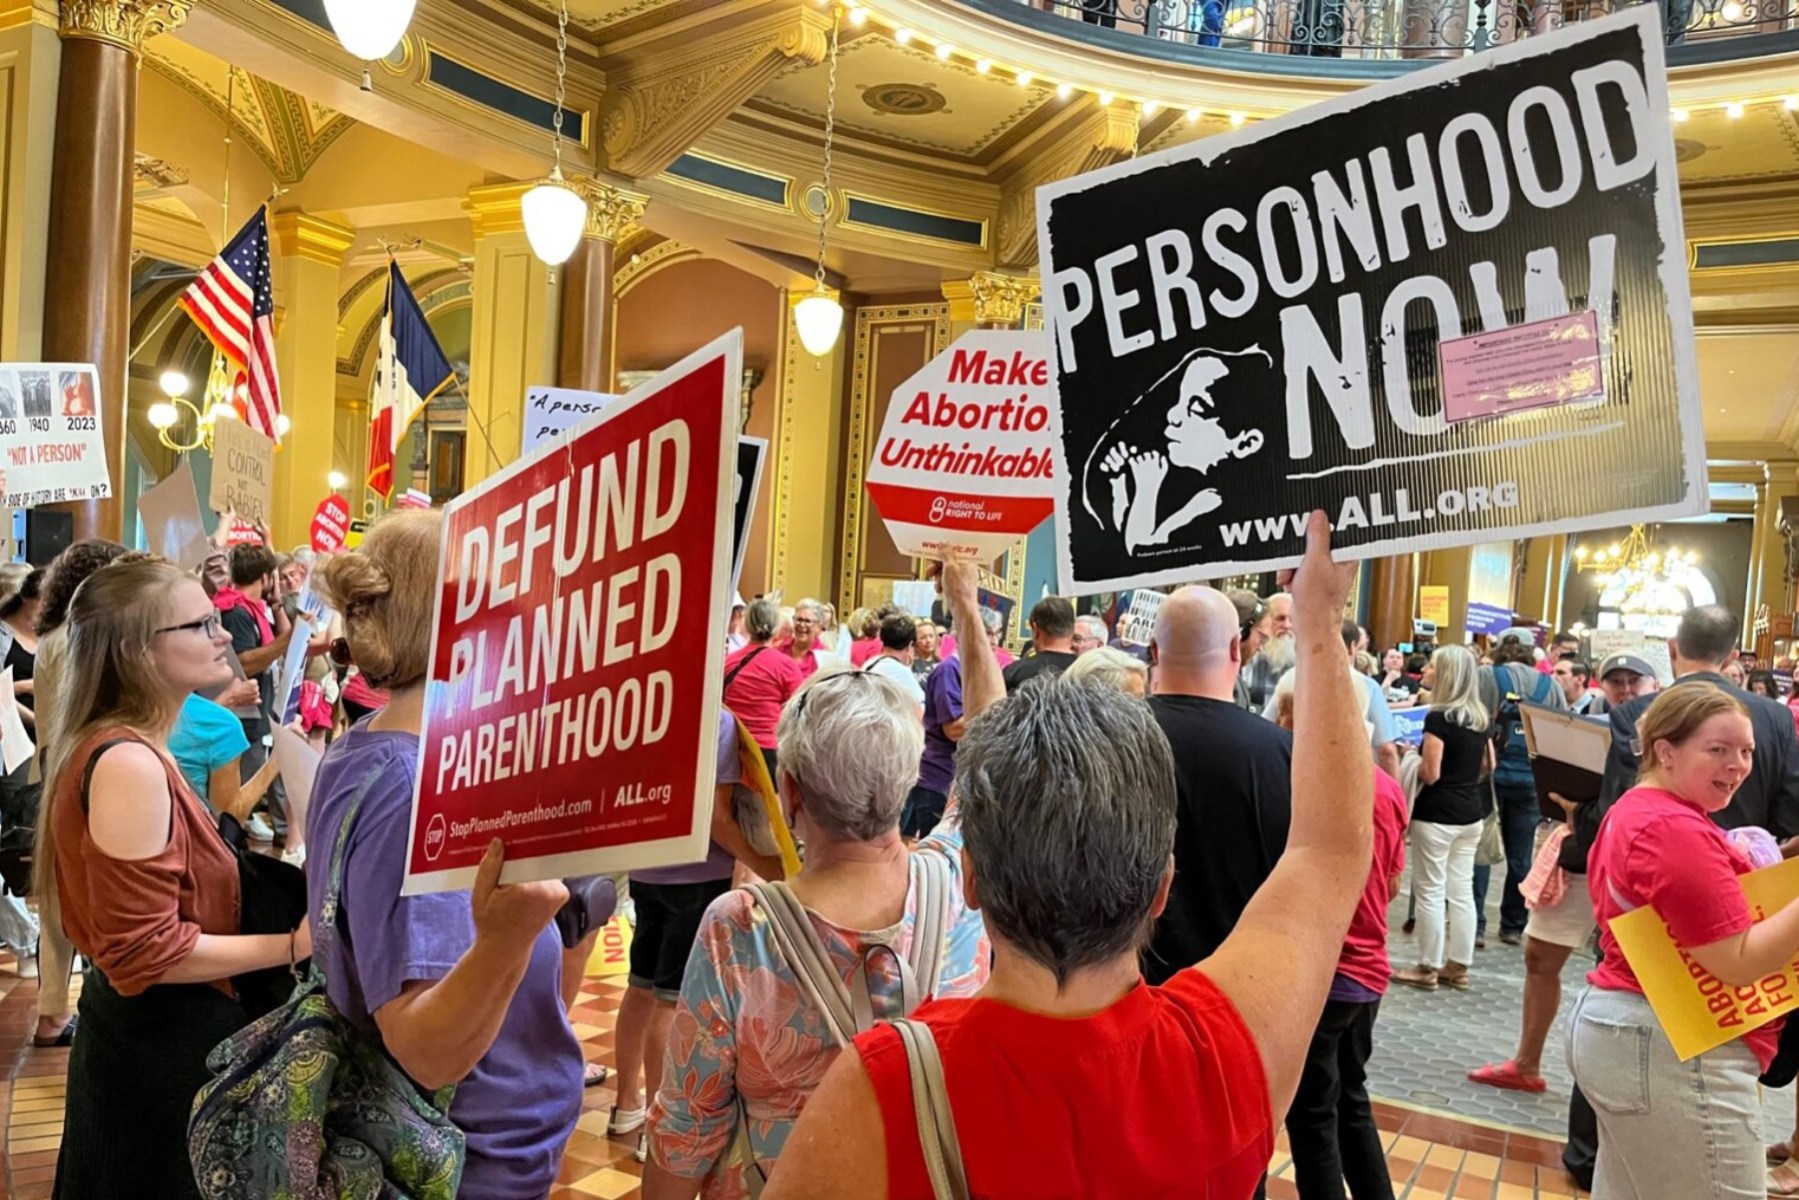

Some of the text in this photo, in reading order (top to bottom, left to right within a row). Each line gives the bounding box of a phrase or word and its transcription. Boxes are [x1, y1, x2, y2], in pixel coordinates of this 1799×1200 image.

[1052, 59, 1658, 374] PERSONHOOD
[947, 349, 1048, 386] Make
[67, 416, 97, 431] 2023
[901, 391, 1051, 432] Abortio
[227, 447, 267, 487] CONTROL
[325, 501, 347, 524] STOP
[455, 418, 691, 625] DEFUND
[945, 508, 1003, 521] RIGHT TO LIFE
[947, 501, 985, 510] national
[444, 552, 682, 720] PLANNED
[435, 669, 674, 796] PARENTHOOD
[449, 799, 592, 838] StopPlannedParenthood.com
[613, 782, 672, 808] ALL.org
[427, 829, 443, 845] STOP
